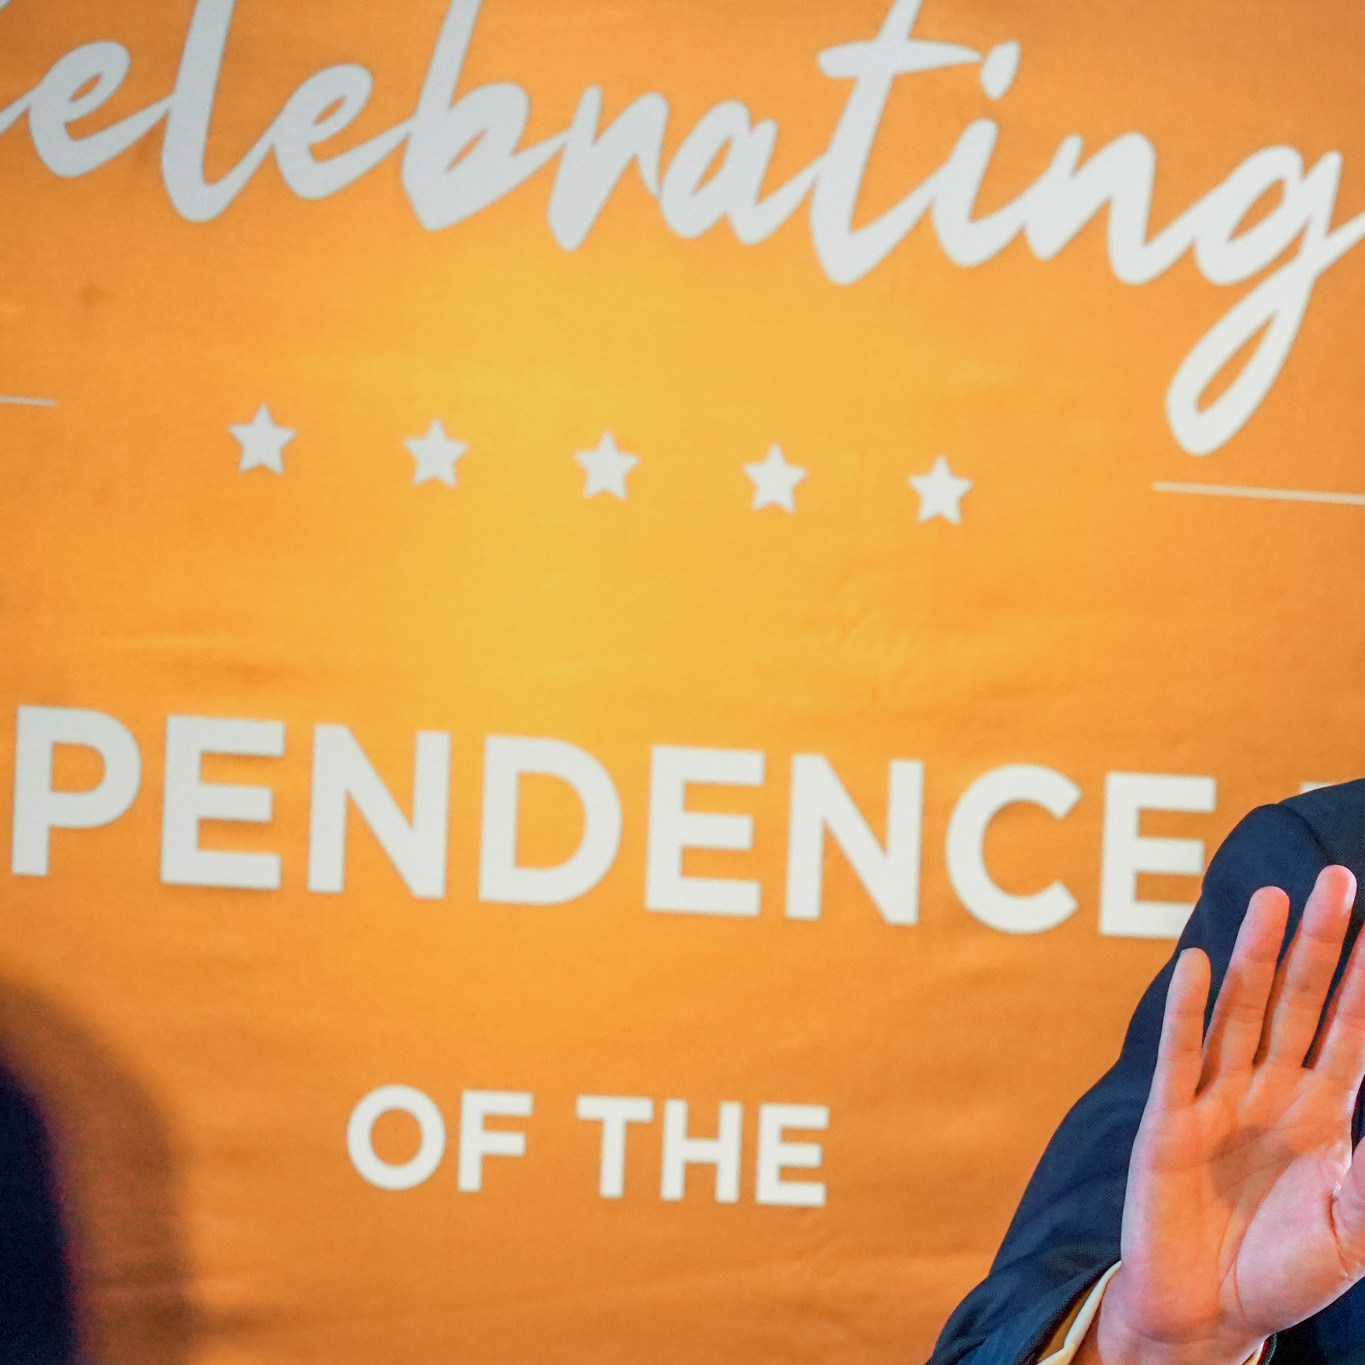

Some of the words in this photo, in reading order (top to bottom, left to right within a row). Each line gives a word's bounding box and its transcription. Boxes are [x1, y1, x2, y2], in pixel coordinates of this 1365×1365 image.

[10, 704, 1218, 941] PENDENCE
[345, 1084, 535, 1193] OF
[575, 1093, 830, 1207] THE
